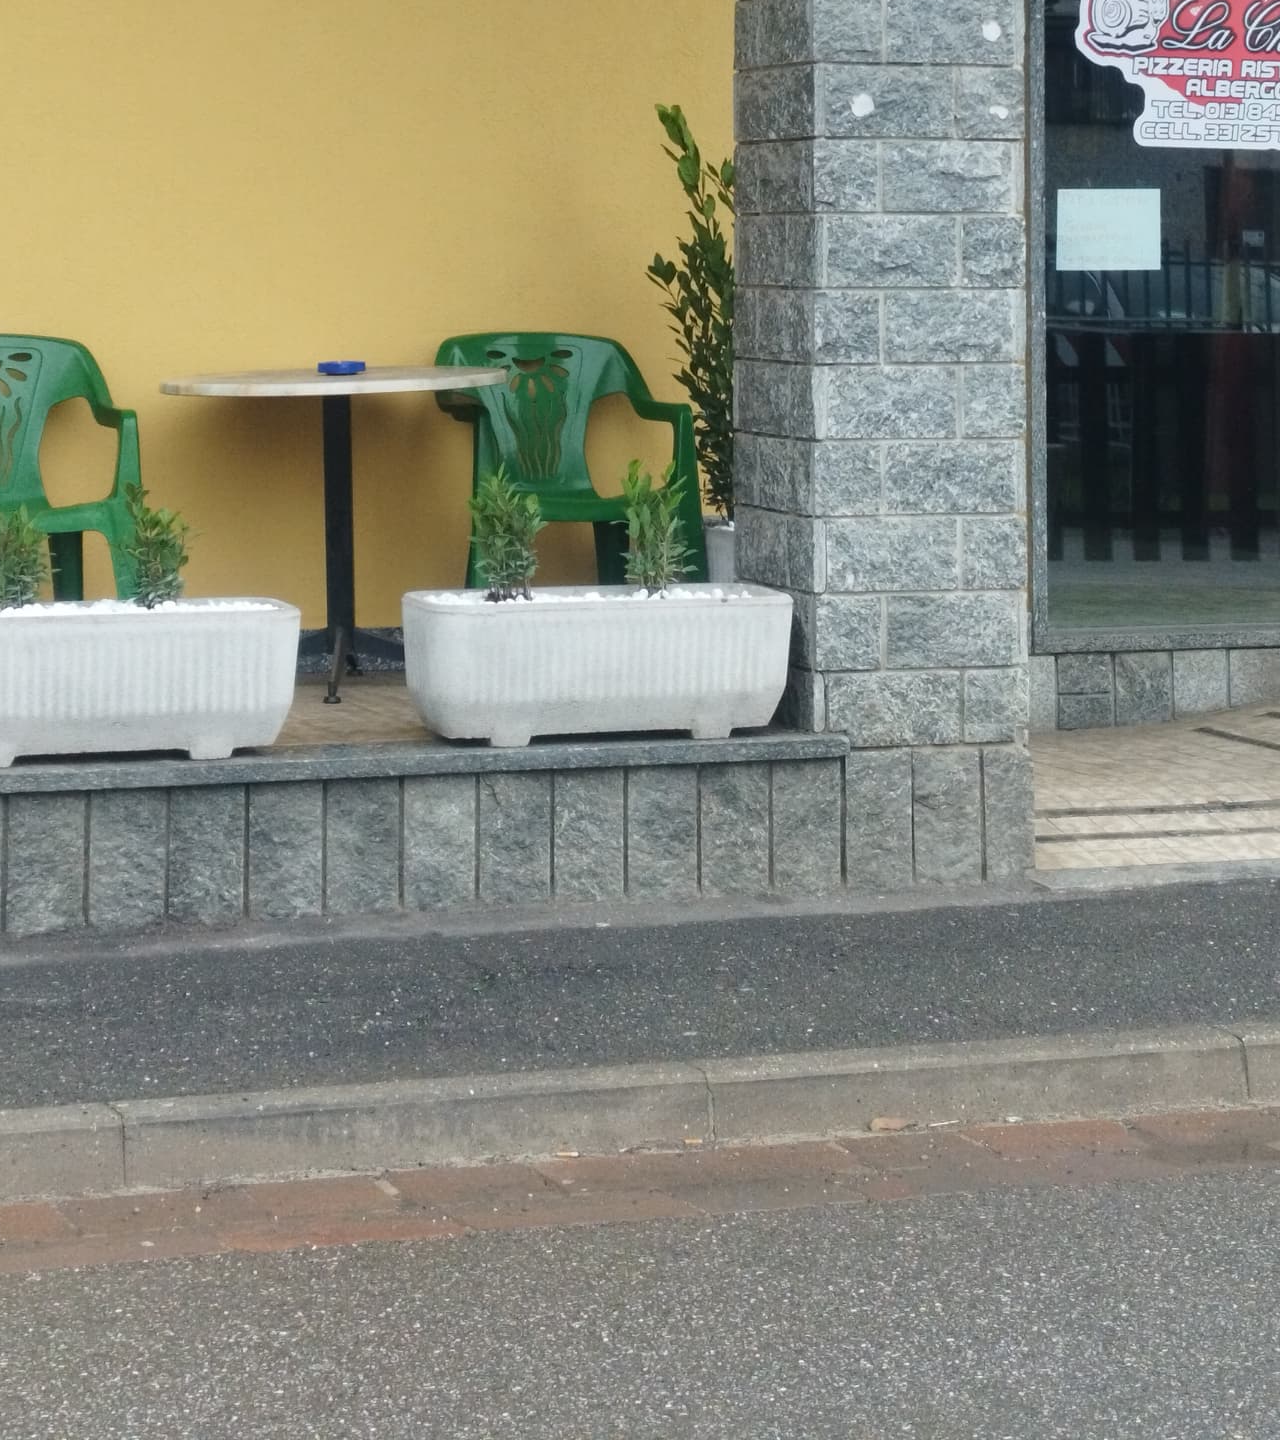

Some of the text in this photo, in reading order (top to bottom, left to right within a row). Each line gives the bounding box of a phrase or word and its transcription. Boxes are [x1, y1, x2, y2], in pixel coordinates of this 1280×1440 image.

[1132, 56, 1232, 77] PIZZERIA
[1205, 102, 1245, 120] 0131
[1140, 121, 1202, 140] CELL.
[1204, 123, 1239, 141] 331
